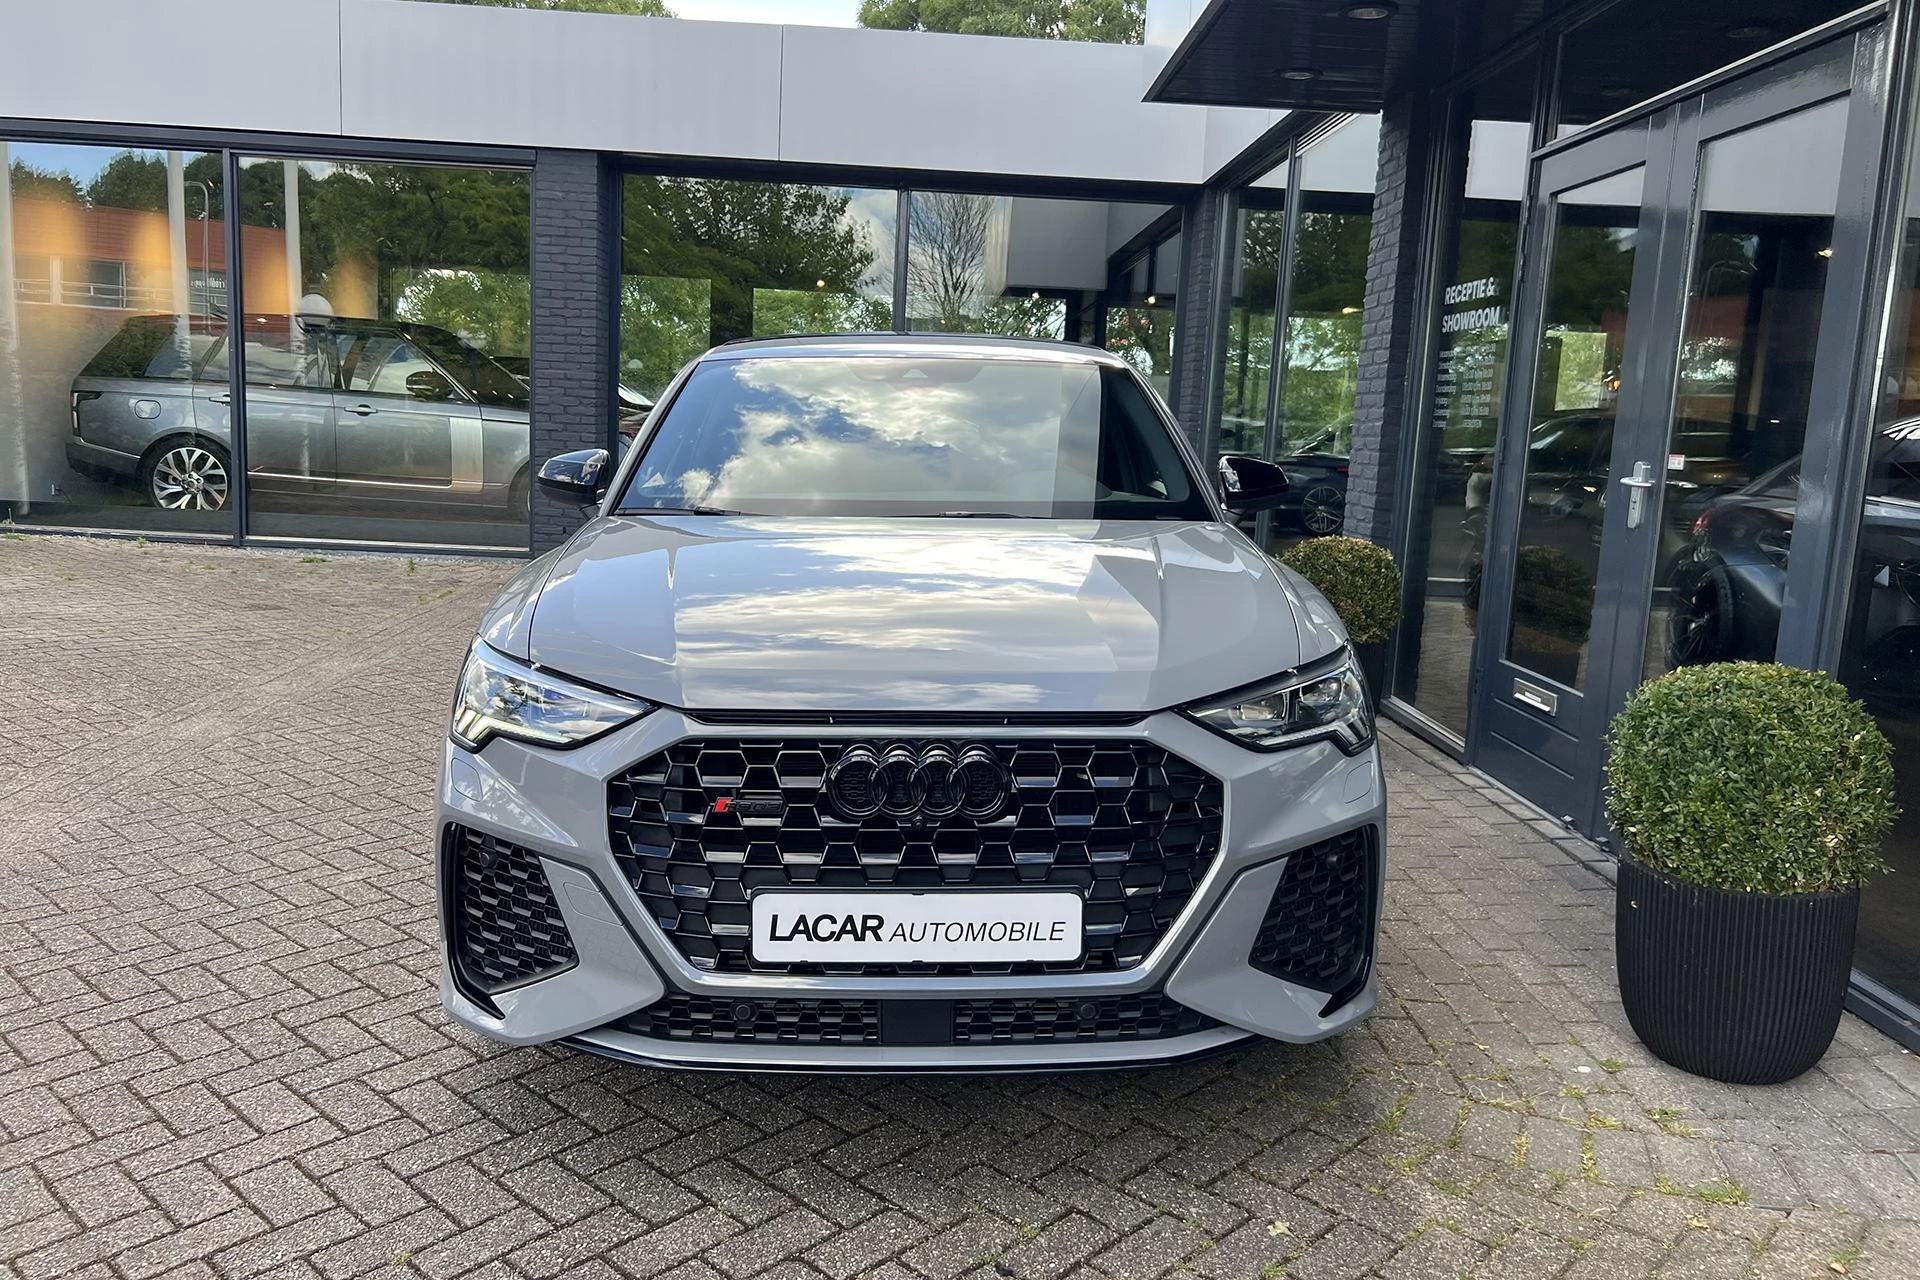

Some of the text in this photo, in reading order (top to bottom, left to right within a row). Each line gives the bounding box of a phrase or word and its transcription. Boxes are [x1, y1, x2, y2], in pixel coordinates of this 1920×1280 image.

[1444, 276, 1495, 305] RECEPTIE &
[1441, 305, 1500, 333] SHOWROOM
[769, 914, 1066, 942] LACAR AUTOMOBILE
